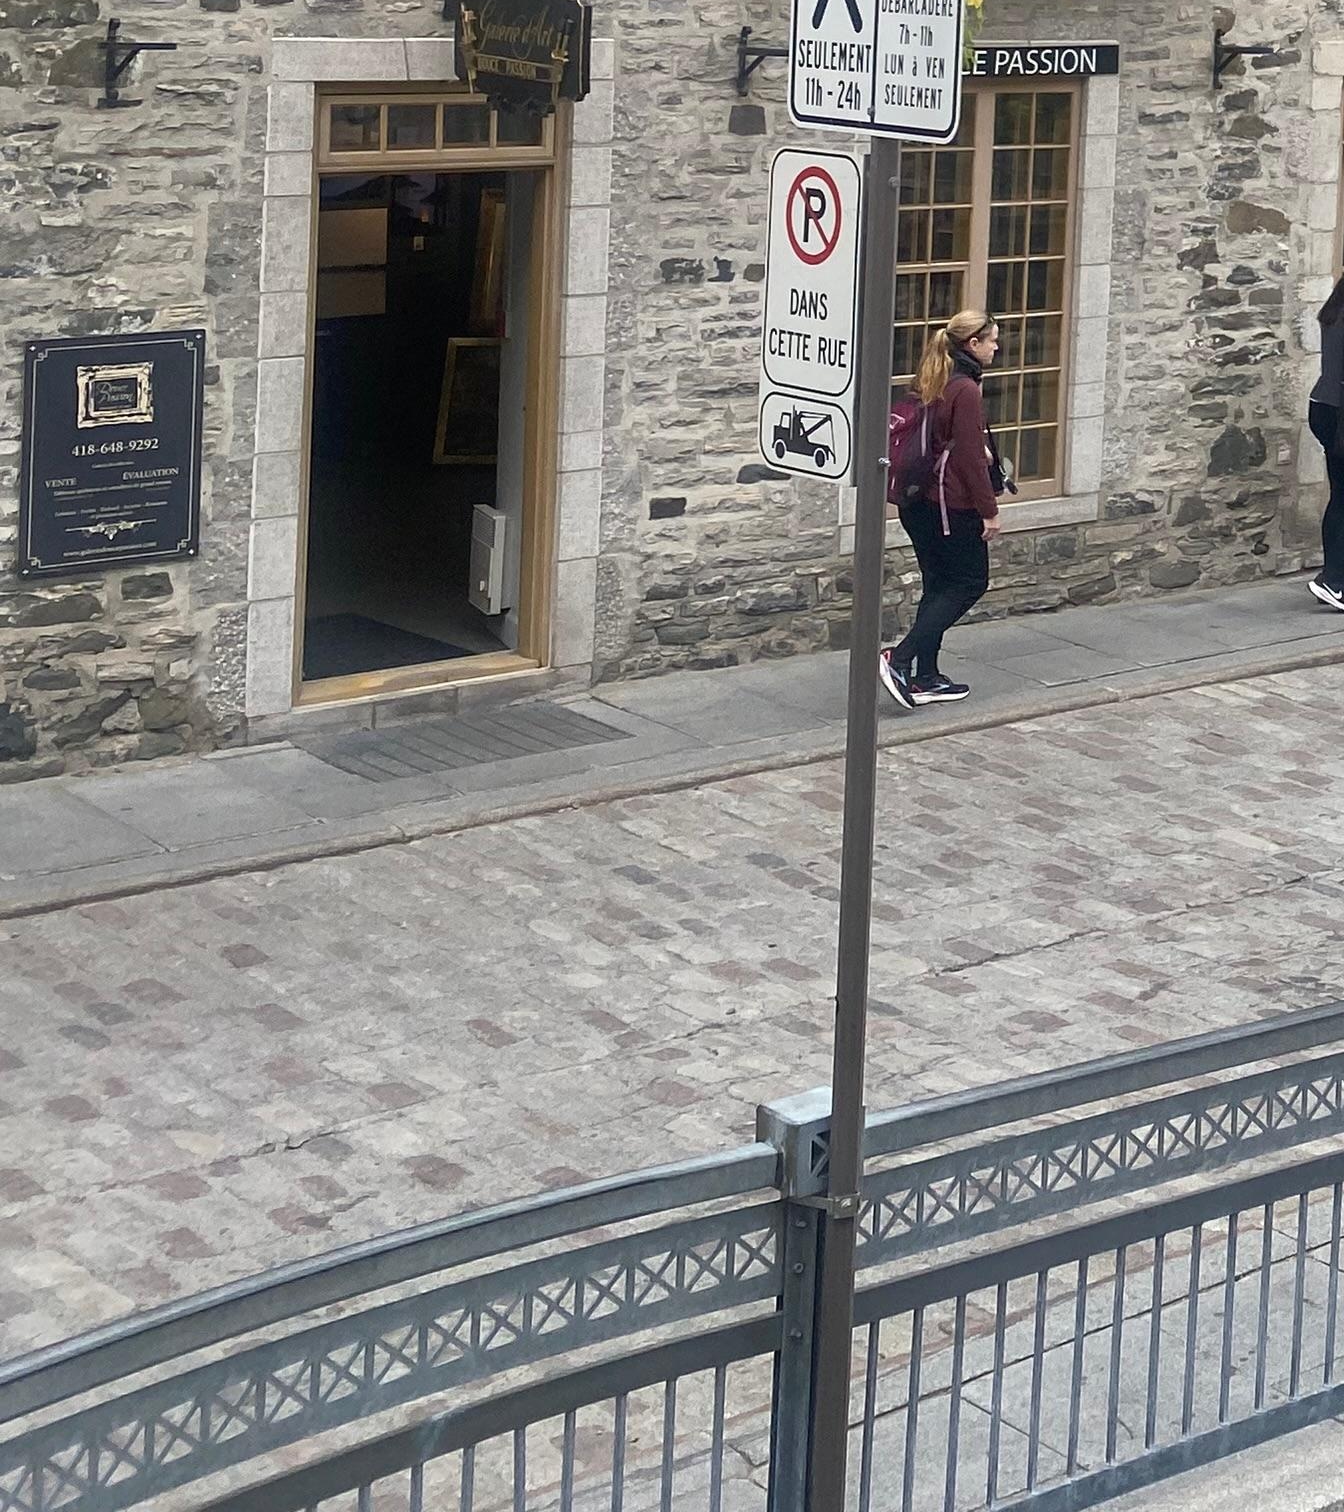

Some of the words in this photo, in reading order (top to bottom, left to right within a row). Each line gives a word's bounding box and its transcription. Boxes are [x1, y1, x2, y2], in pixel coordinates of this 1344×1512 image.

[797, 38, 872, 74] SEULEMENT
[883, 53, 905, 75] LUN
[925, 56, 946, 79] VEN
[994, 48, 1097, 76] PASSION
[804, 76, 823, 107] 11h
[836, 79, 862, 111] 24h
[883, 83, 944, 110] SEULEMENT
[789, 288, 828, 321] DANS
[768, 327, 812, 362] CETTE
[817, 336, 848, 369] RUE
[71, 438, 159, 457] 418-648-9292
[44, 477, 78, 489] VENTE
